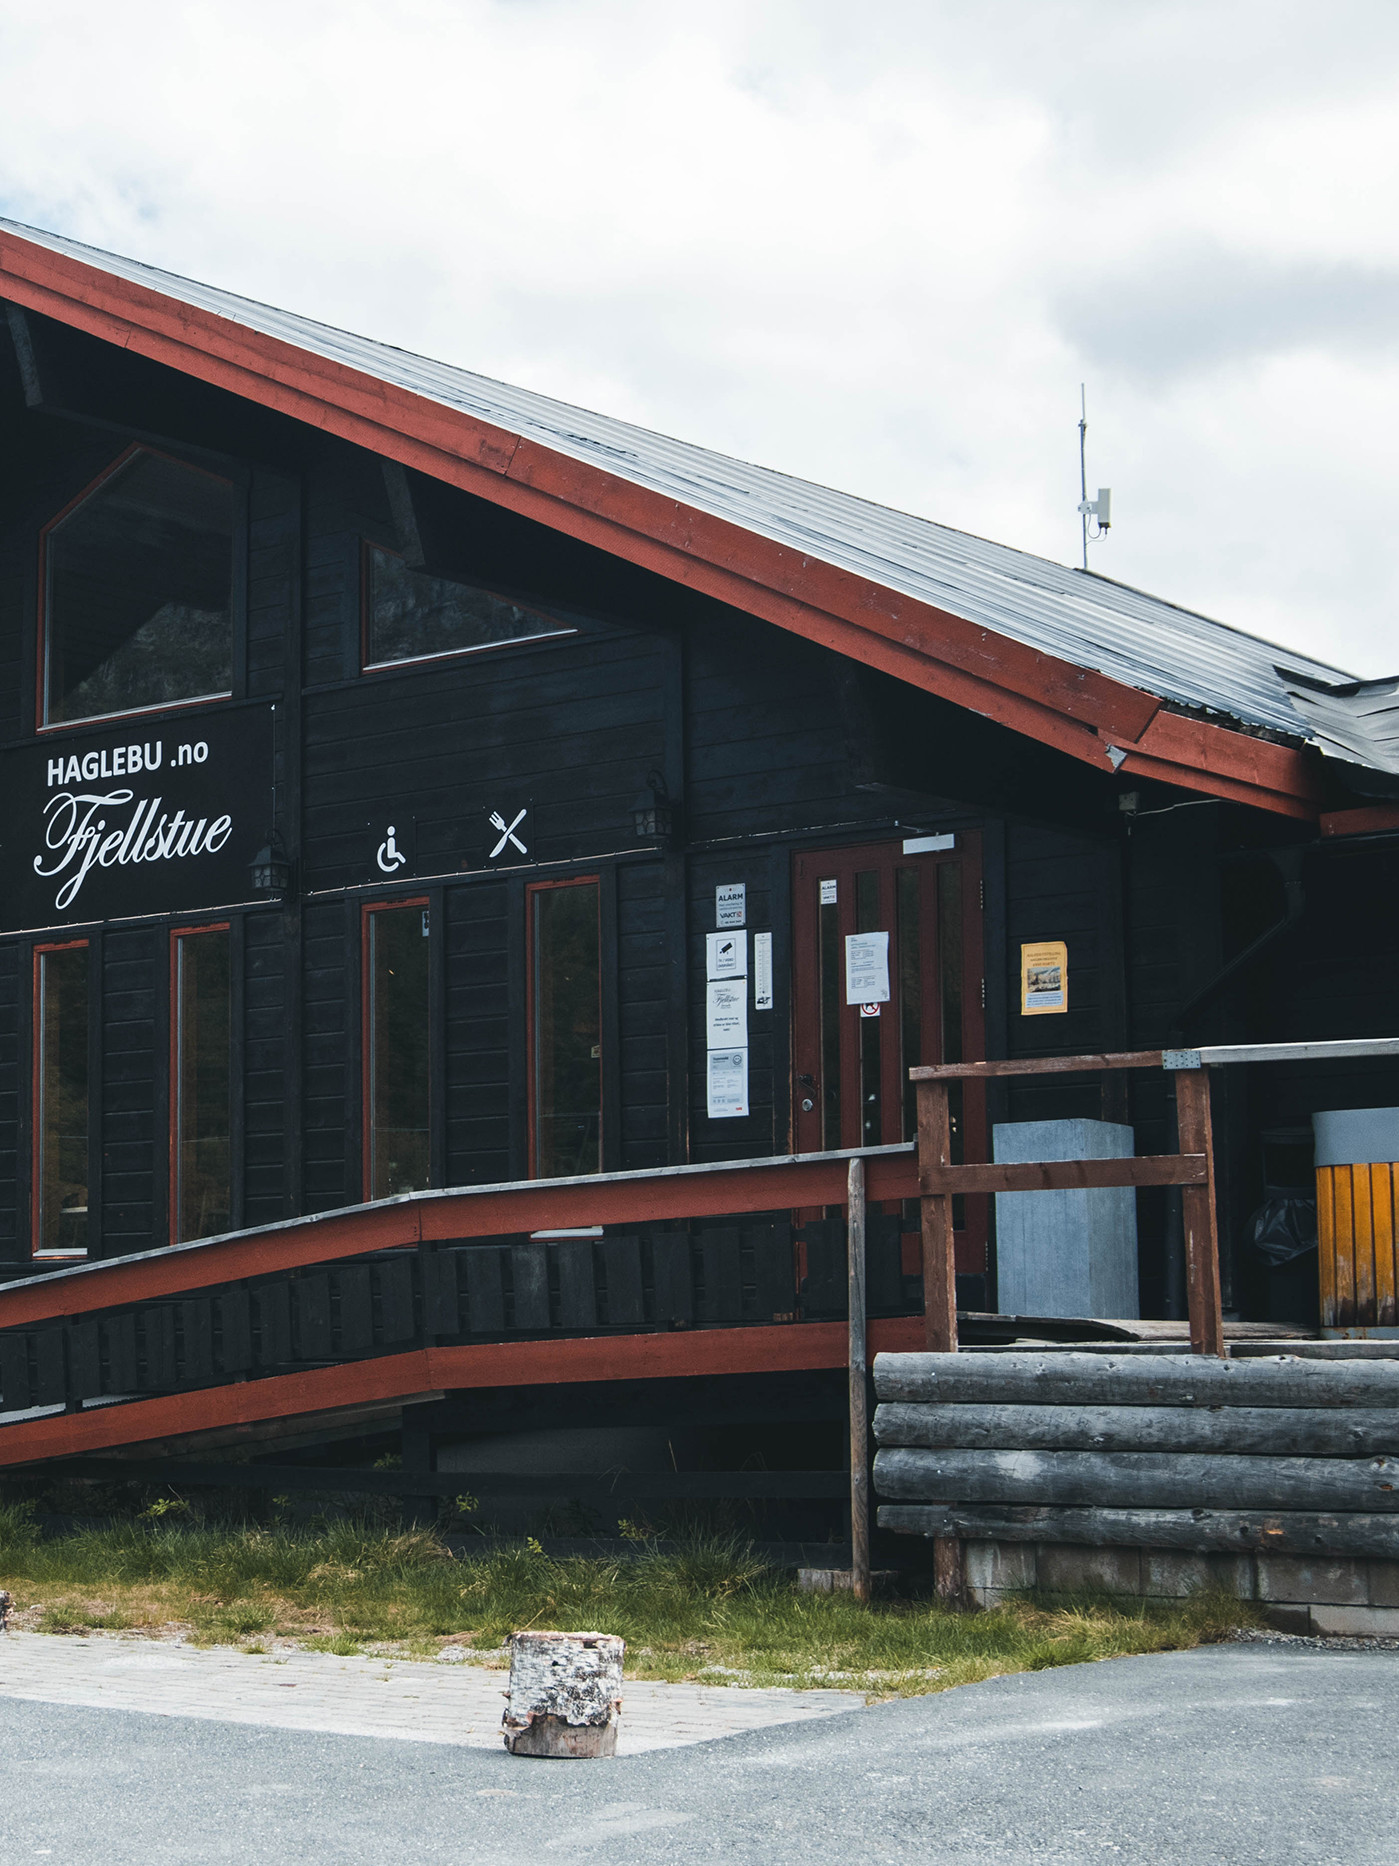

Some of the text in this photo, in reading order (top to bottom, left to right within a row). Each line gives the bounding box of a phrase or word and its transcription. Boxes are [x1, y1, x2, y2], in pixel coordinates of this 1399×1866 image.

[47, 741, 209, 787] HAGLEBU .no
[33, 789, 233, 910] Fjellstue
[718, 893, 744, 902] ALARM
